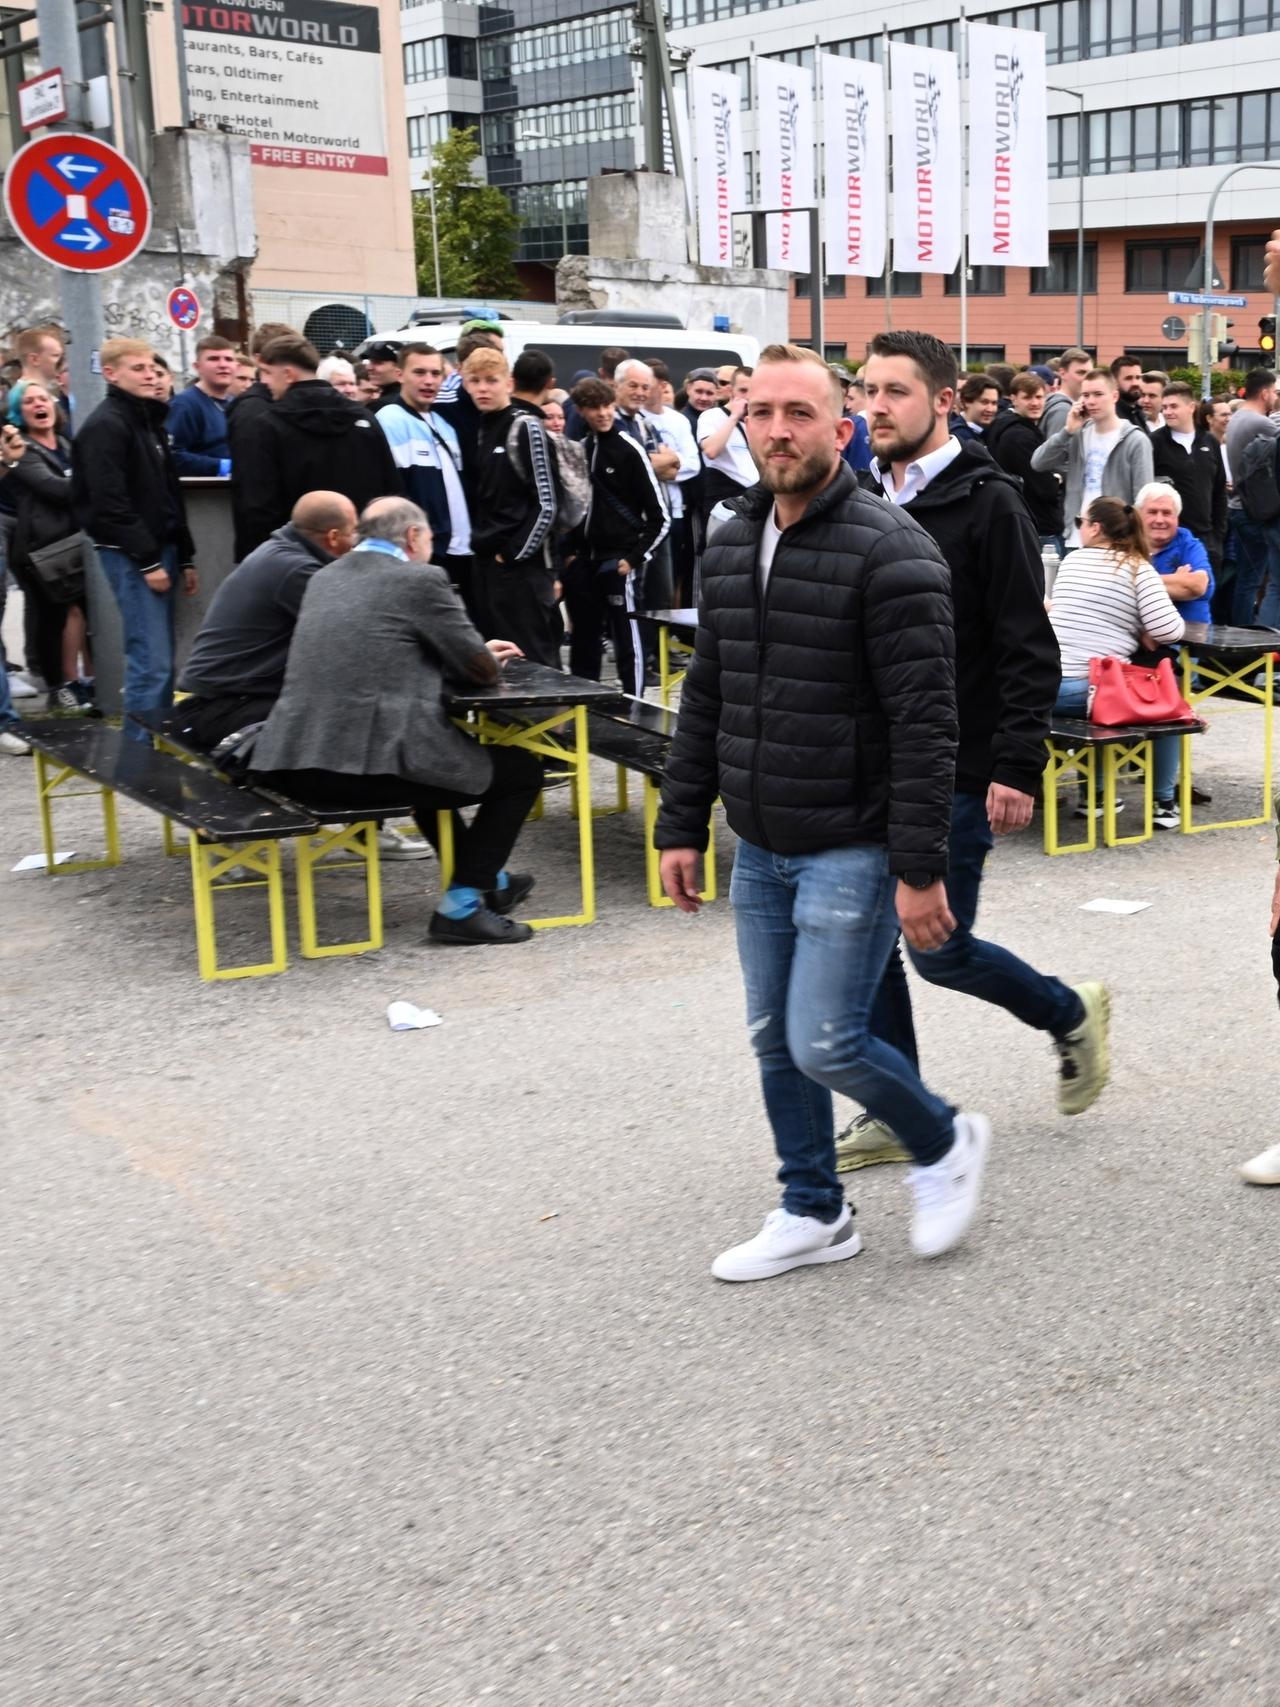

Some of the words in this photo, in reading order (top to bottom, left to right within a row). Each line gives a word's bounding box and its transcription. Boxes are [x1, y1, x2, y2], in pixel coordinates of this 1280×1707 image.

[249, 46, 282, 62] Bars,
[286, 50, 324, 66] Cafés
[187, 63, 220, 78] cars,
[224, 66, 284, 83] Oldtimer
[220, 89, 320, 110] Entertainment
[192, 110, 273, 128] terne-Hotel
[283, 131, 361, 149] Motorworld
[262, 147, 302, 164] FREE
[305, 152, 357, 169] ENTRY
[992, 53, 1012, 254] MOTORWORLD
[711, 92, 729, 261] MOTORWORLD
[844, 82, 861, 265] MOTORWORLD
[913, 72, 933, 262] MOTORWORLD
